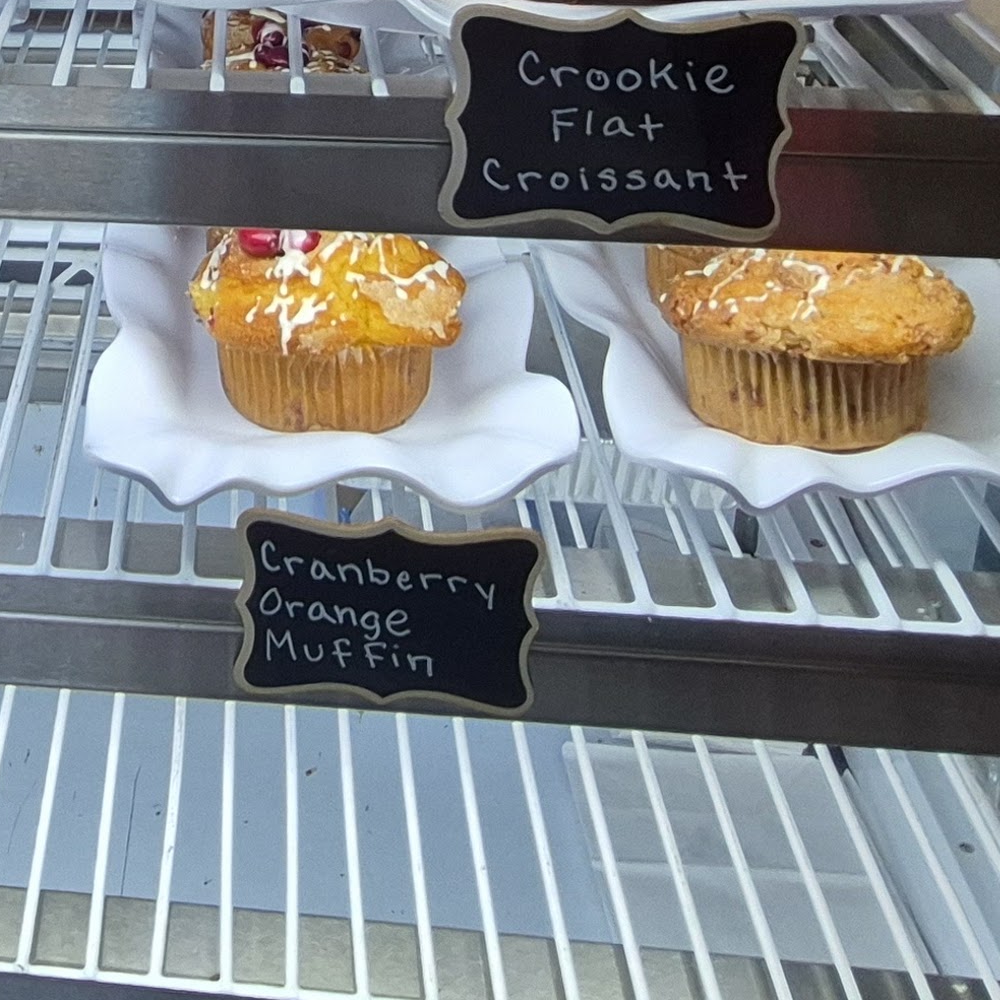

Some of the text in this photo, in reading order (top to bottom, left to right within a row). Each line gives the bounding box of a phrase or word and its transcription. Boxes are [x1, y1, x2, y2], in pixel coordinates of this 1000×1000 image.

[519, 51, 733, 93] Crookie
[552, 108, 663, 141] Flat
[483, 159, 746, 191] Croissant
[261, 540, 495, 610] Cranberry
[259, 587, 410, 639] Orange
[266, 628, 432, 677] Muffin
